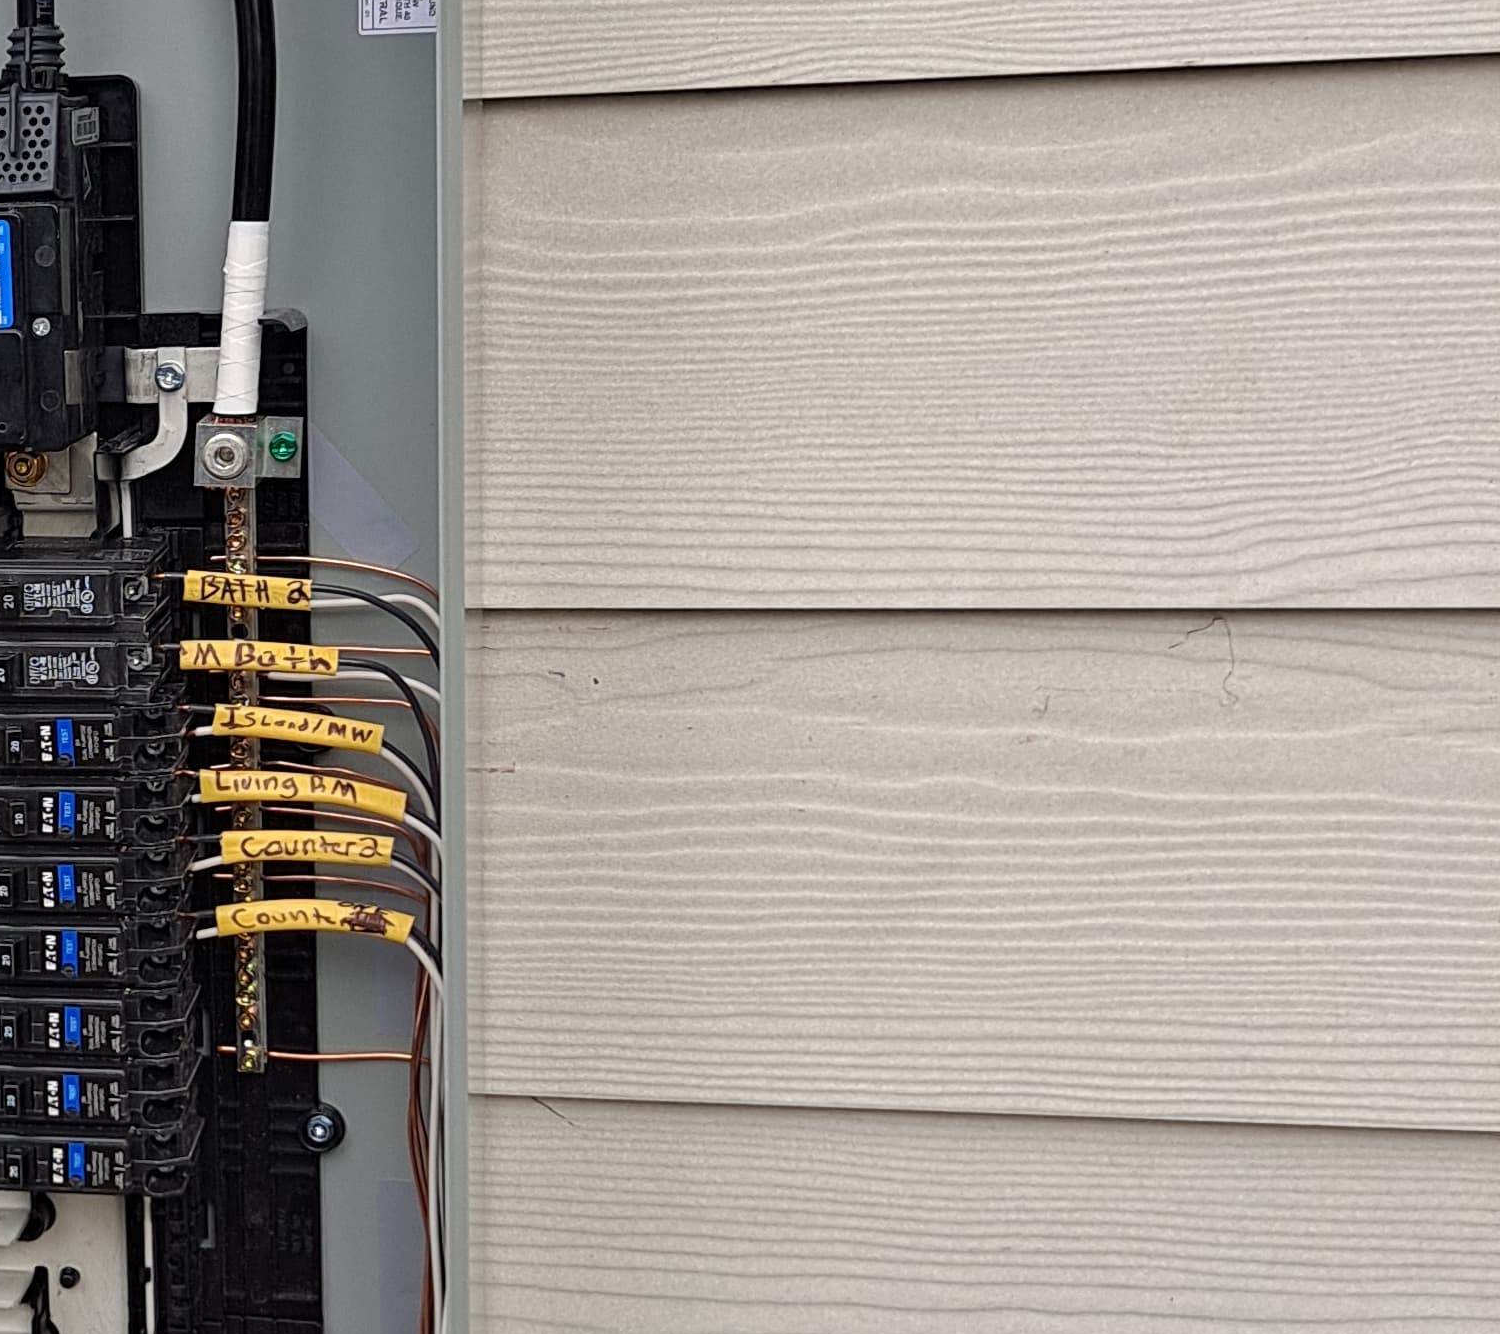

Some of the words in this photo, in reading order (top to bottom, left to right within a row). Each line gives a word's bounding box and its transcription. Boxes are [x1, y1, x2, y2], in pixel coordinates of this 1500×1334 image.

[3, 594, 15, 609] 20
[200, 575, 270, 604] BATH
[286, 581, 311, 604] 2
[193, 643, 221, 666] M
[234, 643, 333, 671] Bath
[10, 740, 20, 753] 20
[39, 724, 53, 762] EATON
[60, 728, 69, 744] TEST
[215, 771, 299, 799] Living
[14, 812, 24, 825] 20
[41, 797, 54, 833] EATON
[64, 801, 72, 818] TEST
[0, 884, 9, 898] 20
[41, 871, 55, 908] EATON
[64, 874, 72, 891] TEST
[1, 954, 11, 967] 20
[45, 934, 57, 971] EATON
[65, 938, 74, 955] TEST
[48, 1012, 61, 1048] EATON
[47, 1080, 60, 1117] EATON
[52, 1147, 64, 1184] EATON
